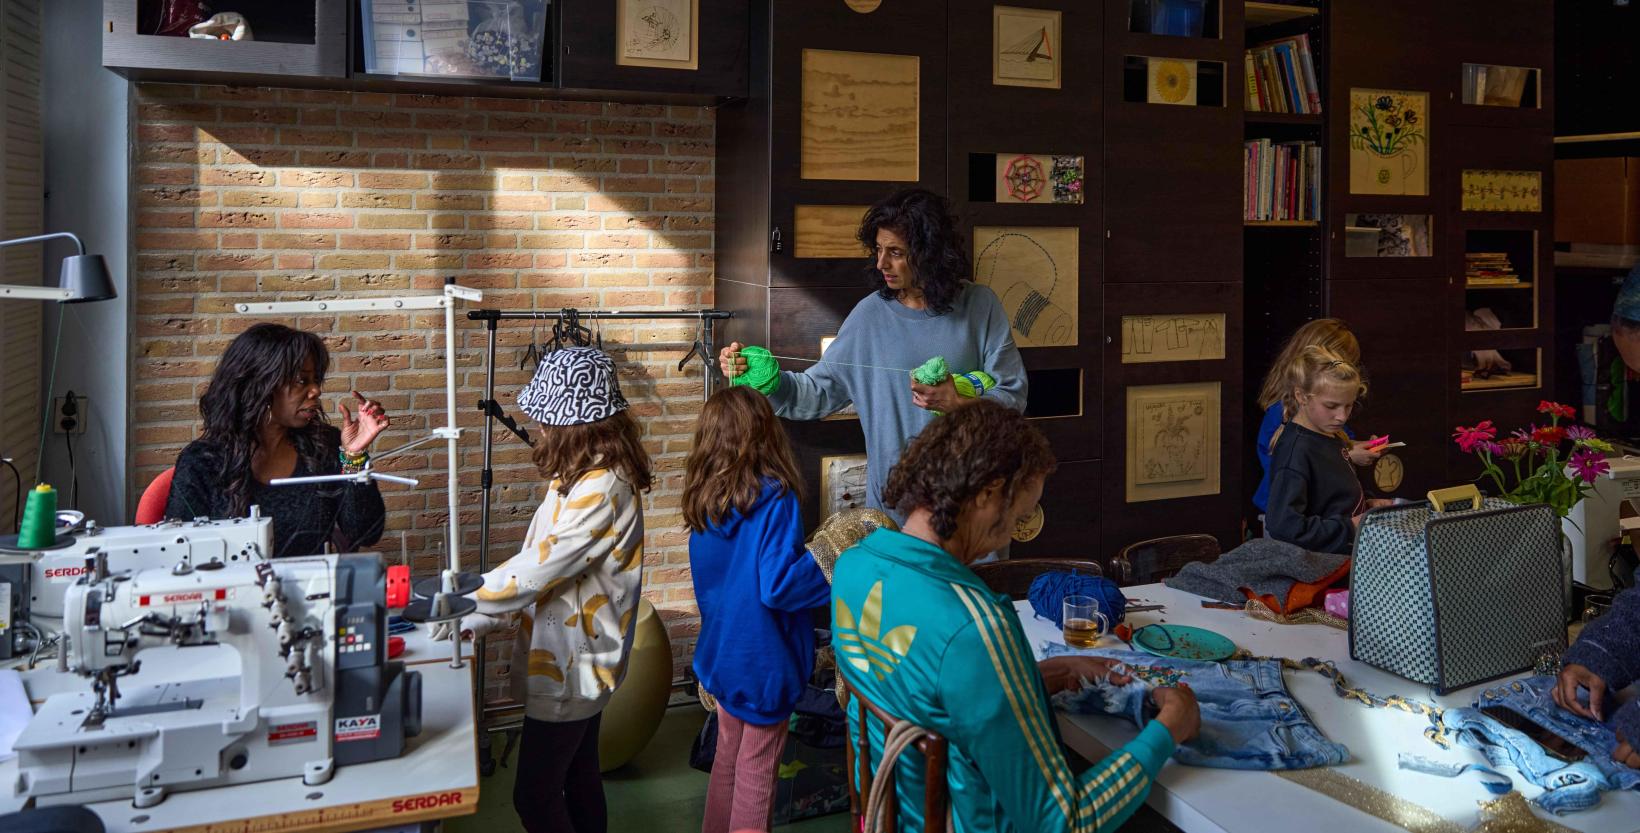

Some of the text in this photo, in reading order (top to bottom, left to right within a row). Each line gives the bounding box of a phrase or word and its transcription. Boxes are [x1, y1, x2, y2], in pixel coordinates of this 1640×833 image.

[164, 593, 202, 602] SERDAR
[339, 718, 376, 728] KAYA
[392, 792, 462, 812] SERDAR
